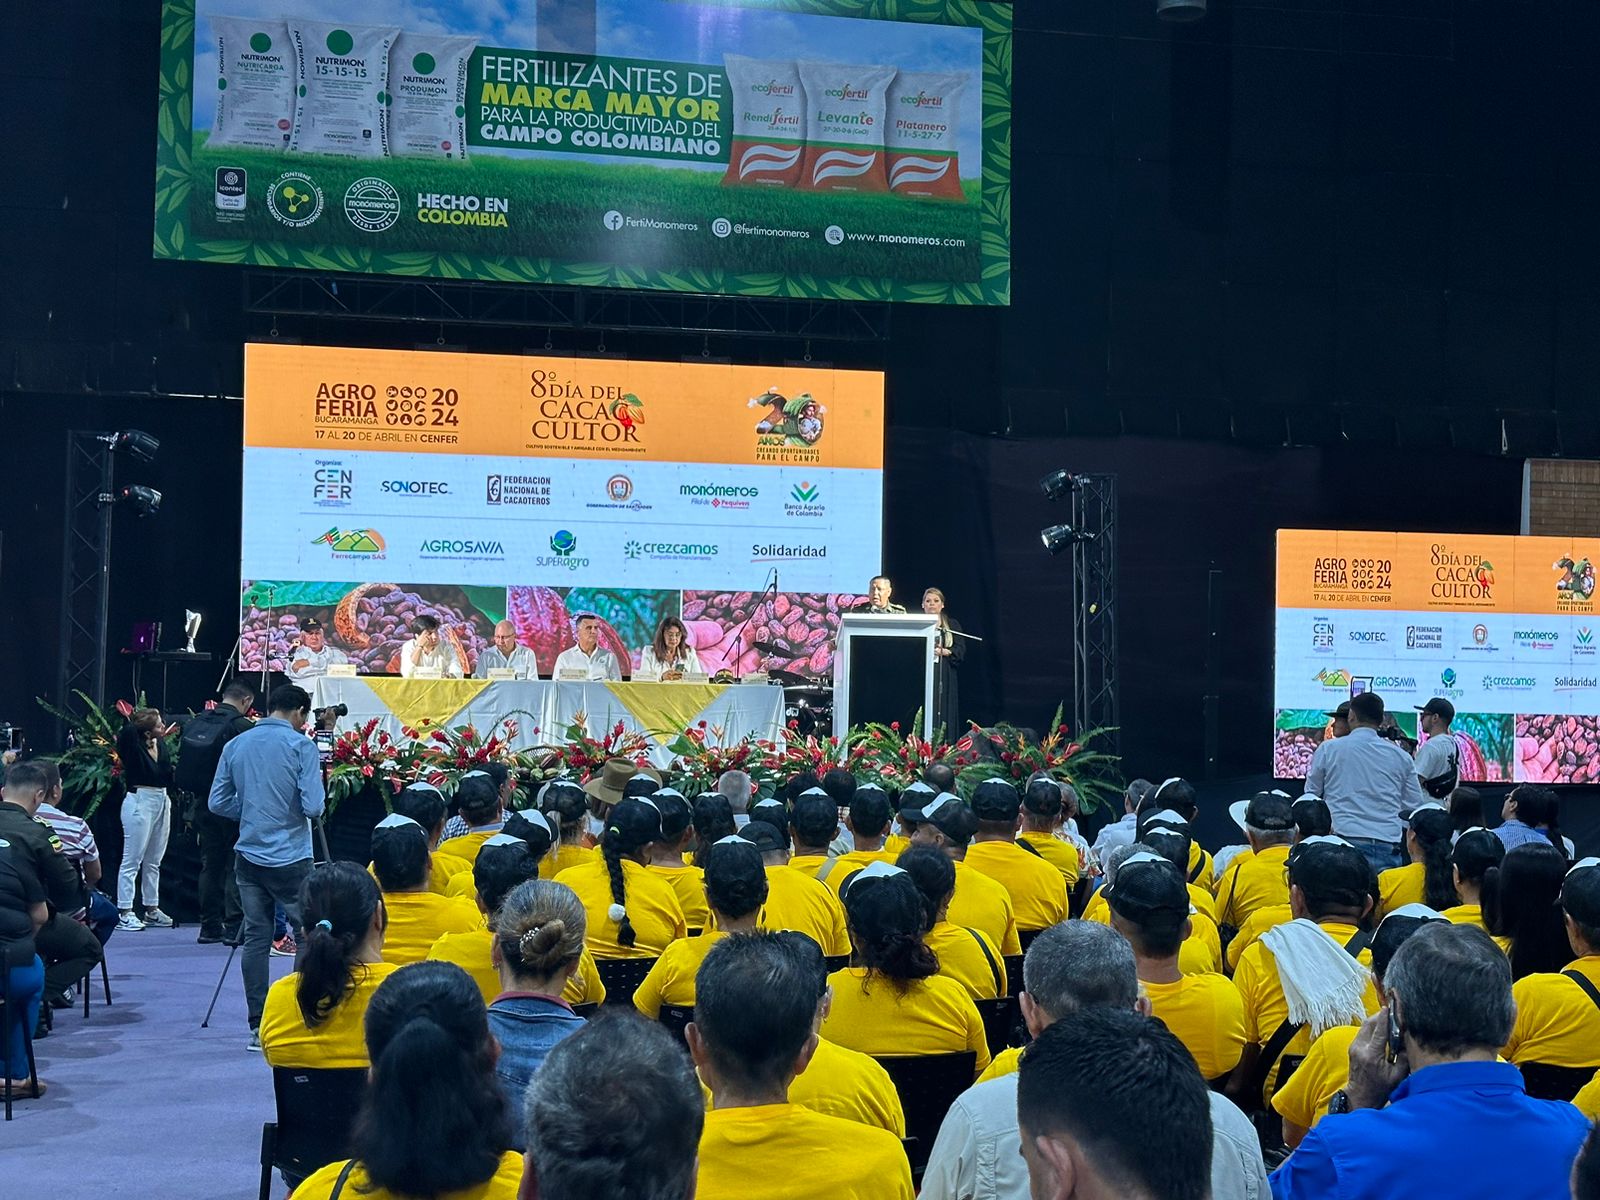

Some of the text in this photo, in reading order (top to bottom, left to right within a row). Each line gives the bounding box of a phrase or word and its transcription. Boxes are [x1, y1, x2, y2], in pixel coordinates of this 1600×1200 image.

[241, 54, 280, 62] NUTRIMON
[316, 57, 364, 67] NUTRIMON
[316, 66, 367, 77] 15-15-15
[482, 56, 678, 94] FERTILIZANTES
[688, 72, 722, 98] DE
[404, 76, 445, 85] NUTRIMON
[400, 85, 448, 94] PRODUMON
[752, 80, 793, 96] ecofertil
[825, 84, 868, 100] ecofertil
[480, 82, 594, 112] MARCA
[605, 92, 720, 122] MAYOR
[901, 90, 943, 108] ecofertil
[481, 106, 721, 138] PARA LA PRODUCTIVIDAD DEL
[818, 111, 874, 126] Levante
[896, 120, 947, 132] Platanero
[480, 124, 720, 156] CAMPO COLOMBIANO
[898, 130, 942, 140] 11-5-27-7
[280, 172, 312, 180] CONTIENE
[352, 180, 394, 196] ORIGINALES
[266, 184, 281, 221] SECUNDARIOS
[348, 200, 396, 210] monómeros
[418, 193, 508, 212] HECHO EN
[352, 216, 393, 230] DESDE 1967
[418, 208, 508, 228] COLOMBIA
[626, 217, 698, 232] FertiMonomeros
[734, 224, 810, 238] @fertimonomeros
[848, 233, 965, 247] www.monomeros.com
[316, 383, 376, 400] AGRO
[431, 388, 458, 406] 20
[550, 380, 584, 398] DÍA
[590, 386, 626, 400] DEL
[316, 400, 378, 418] FERIA
[314, 416, 378, 424] BUCARAMANGA
[430, 408, 459, 426] 24
[315, 430, 325, 439] 17
[328, 431, 340, 440] AL
[342, 432, 356, 440] 20
[358, 432, 372, 440] DE
[374, 433, 400, 442] ABRIL
[420, 434, 458, 444] CENFER
[532, 420, 640, 442] CULTOR
[314, 469, 352, 483] CEN
[504, 476, 550, 484] FEDERACION
[314, 485, 352, 498] FER
[504, 486, 540, 495] NACIONAL
[680, 482, 758, 496] monómeros
[504, 496, 550, 505] CACAOTEROS
[420, 540, 504, 554] AGROSAVIA
[643, 542, 718, 555] crezcamos
[752, 544, 826, 558] Solidaridad
[1314, 558, 1346, 570] AGRO
[1442, 552, 1460, 566] DÍA
[1464, 555, 1482, 566] DEL
[1376, 560, 1392, 574] 20
[1314, 570, 1348, 584] FERIA
[1376, 576, 1392, 589] 24
[1432, 582, 1492, 598] CULTOR
[1314, 624, 1334, 634] CEN
[1514, 629, 1558, 640] monómeros
[1313, 636, 1334, 646] FER
[1374, 676, 1416, 688] GROSAVIA
[1493, 676, 1536, 686] crezcamos
[1554, 676, 1597, 686] Solidaridad
